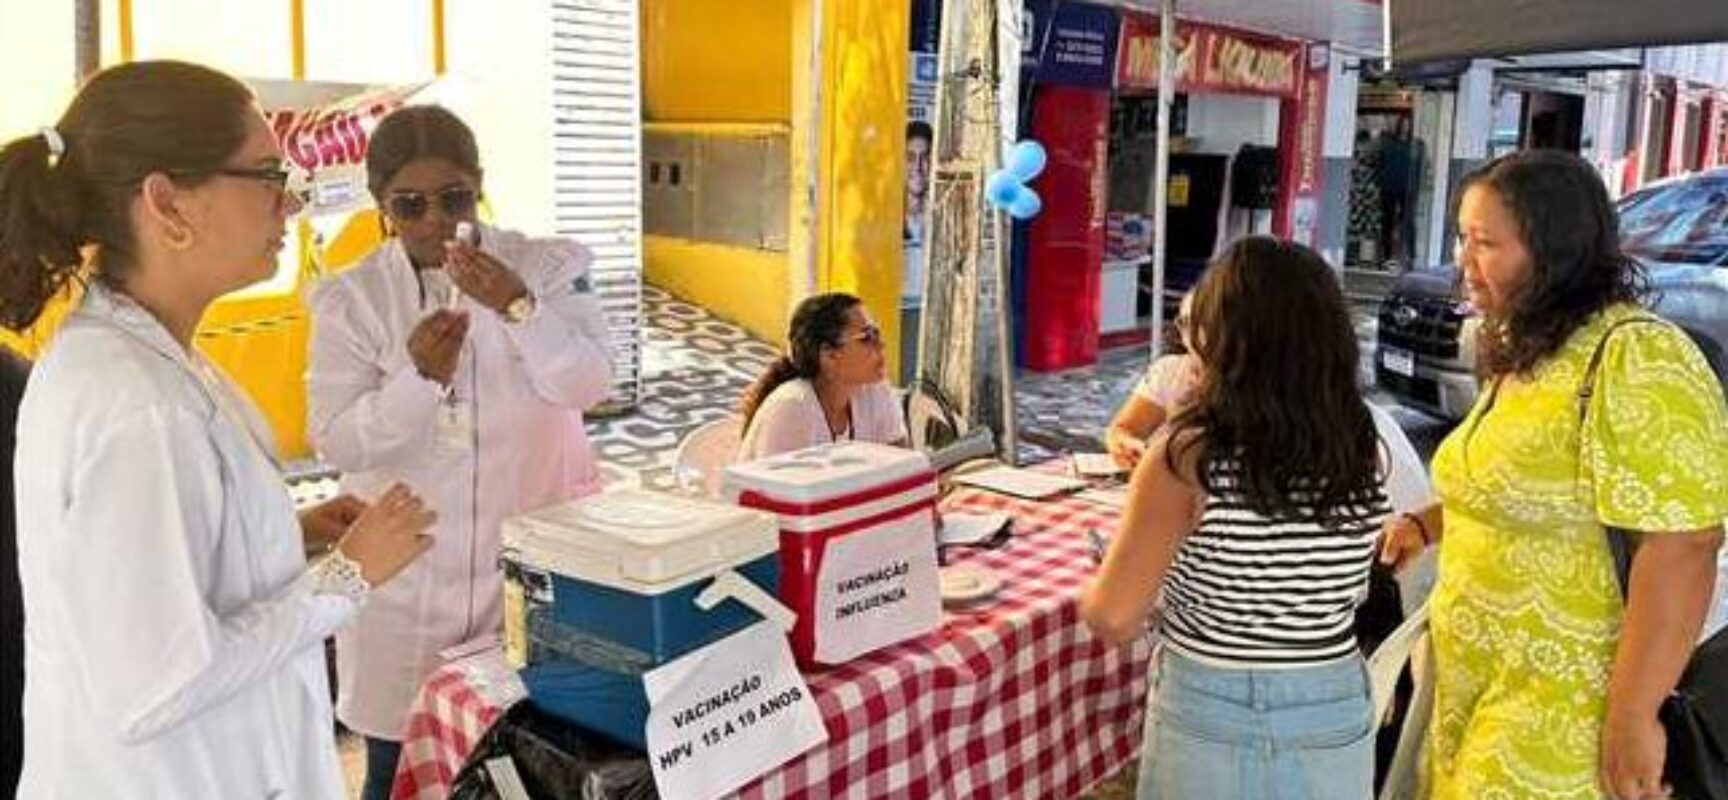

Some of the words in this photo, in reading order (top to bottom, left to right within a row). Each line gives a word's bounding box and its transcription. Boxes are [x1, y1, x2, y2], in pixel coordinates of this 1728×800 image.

[837, 562, 909, 594] VACINAÇÃO
[835, 587, 907, 619] INFLUENZA
[672, 674, 762, 729] VACINAÇÃO
[659, 741, 693, 771] HPV
[702, 727, 721, 747] 15
[724, 721, 735, 737] A
[738, 709, 756, 727] 19
[759, 686, 803, 718] ANOS
